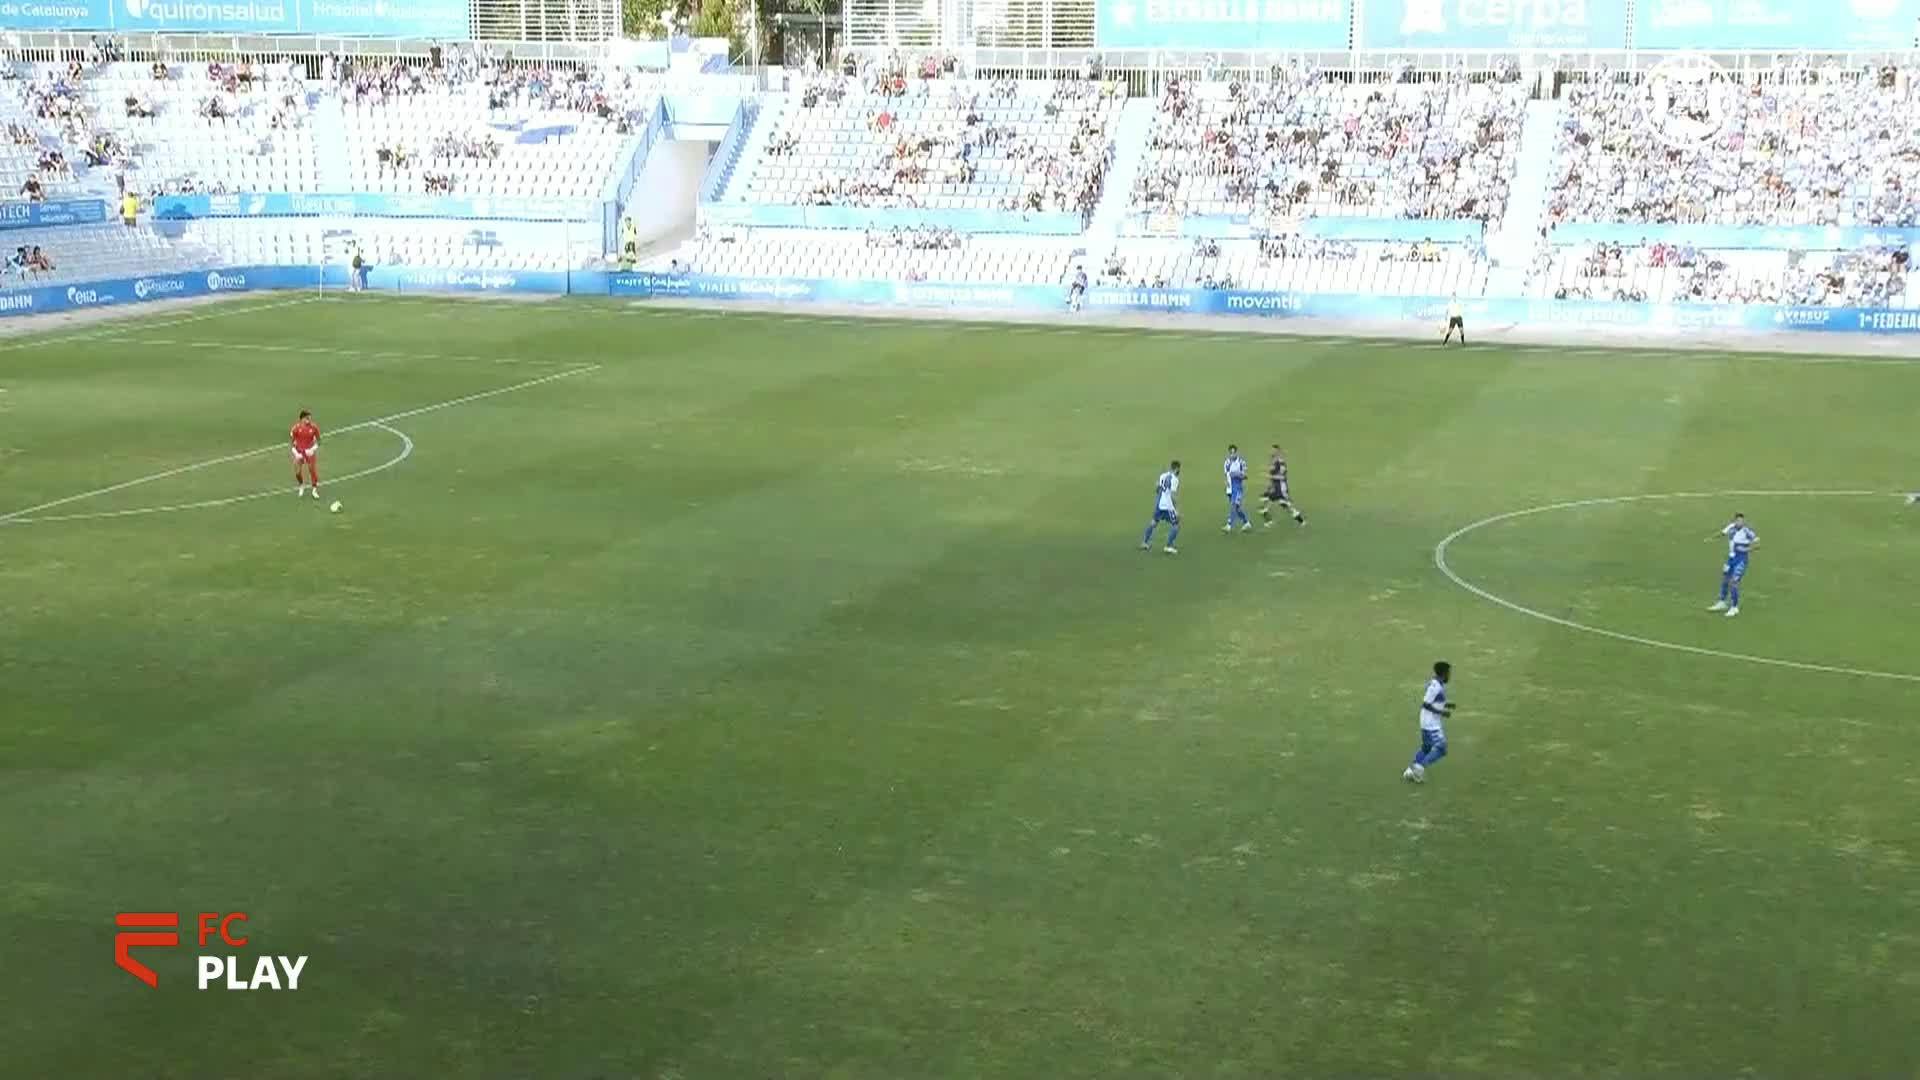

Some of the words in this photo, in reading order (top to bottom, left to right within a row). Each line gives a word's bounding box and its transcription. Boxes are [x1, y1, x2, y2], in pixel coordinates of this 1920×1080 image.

[1, 4, 18, 16] de
[22, 3, 89, 19] Catalunya
[0, 204, 30, 219] TECH
[1150, 293, 1191, 307] DAMM
